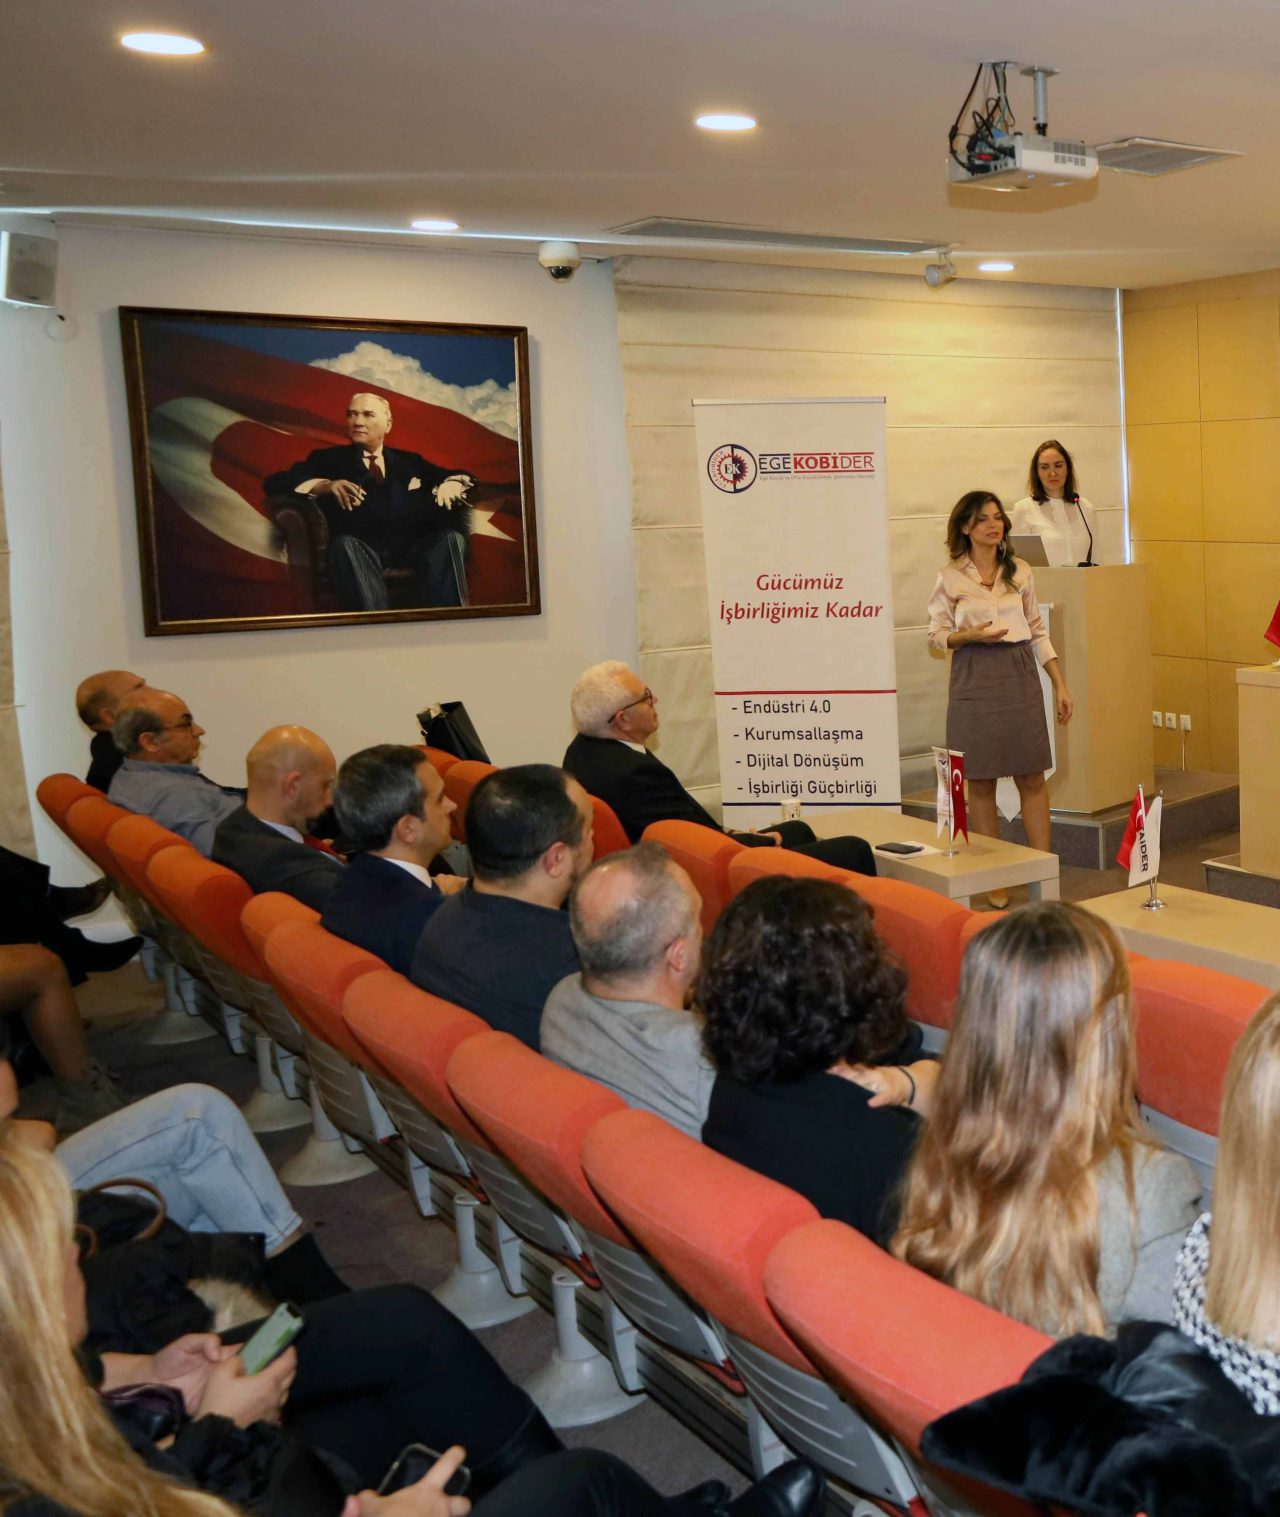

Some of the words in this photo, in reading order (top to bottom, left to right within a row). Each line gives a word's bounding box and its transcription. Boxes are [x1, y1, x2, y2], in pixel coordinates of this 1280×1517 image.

[758, 452, 875, 470] EGEKOBİDER
[756, 573, 844, 591] Gücümüz
[720, 600, 820, 625] İşbirliğimiz
[826, 600, 884, 619] Kadar
[743, 700, 805, 714] Endüstri
[809, 699, 831, 713] 4.0
[744, 727, 864, 744] Kurumsallaşma
[746, 753, 789, 770] Dijital
[793, 753, 865, 770] Dönüşüm
[748, 777, 803, 797] İşbirliği
[807, 780, 878, 797] Güçbirliği
